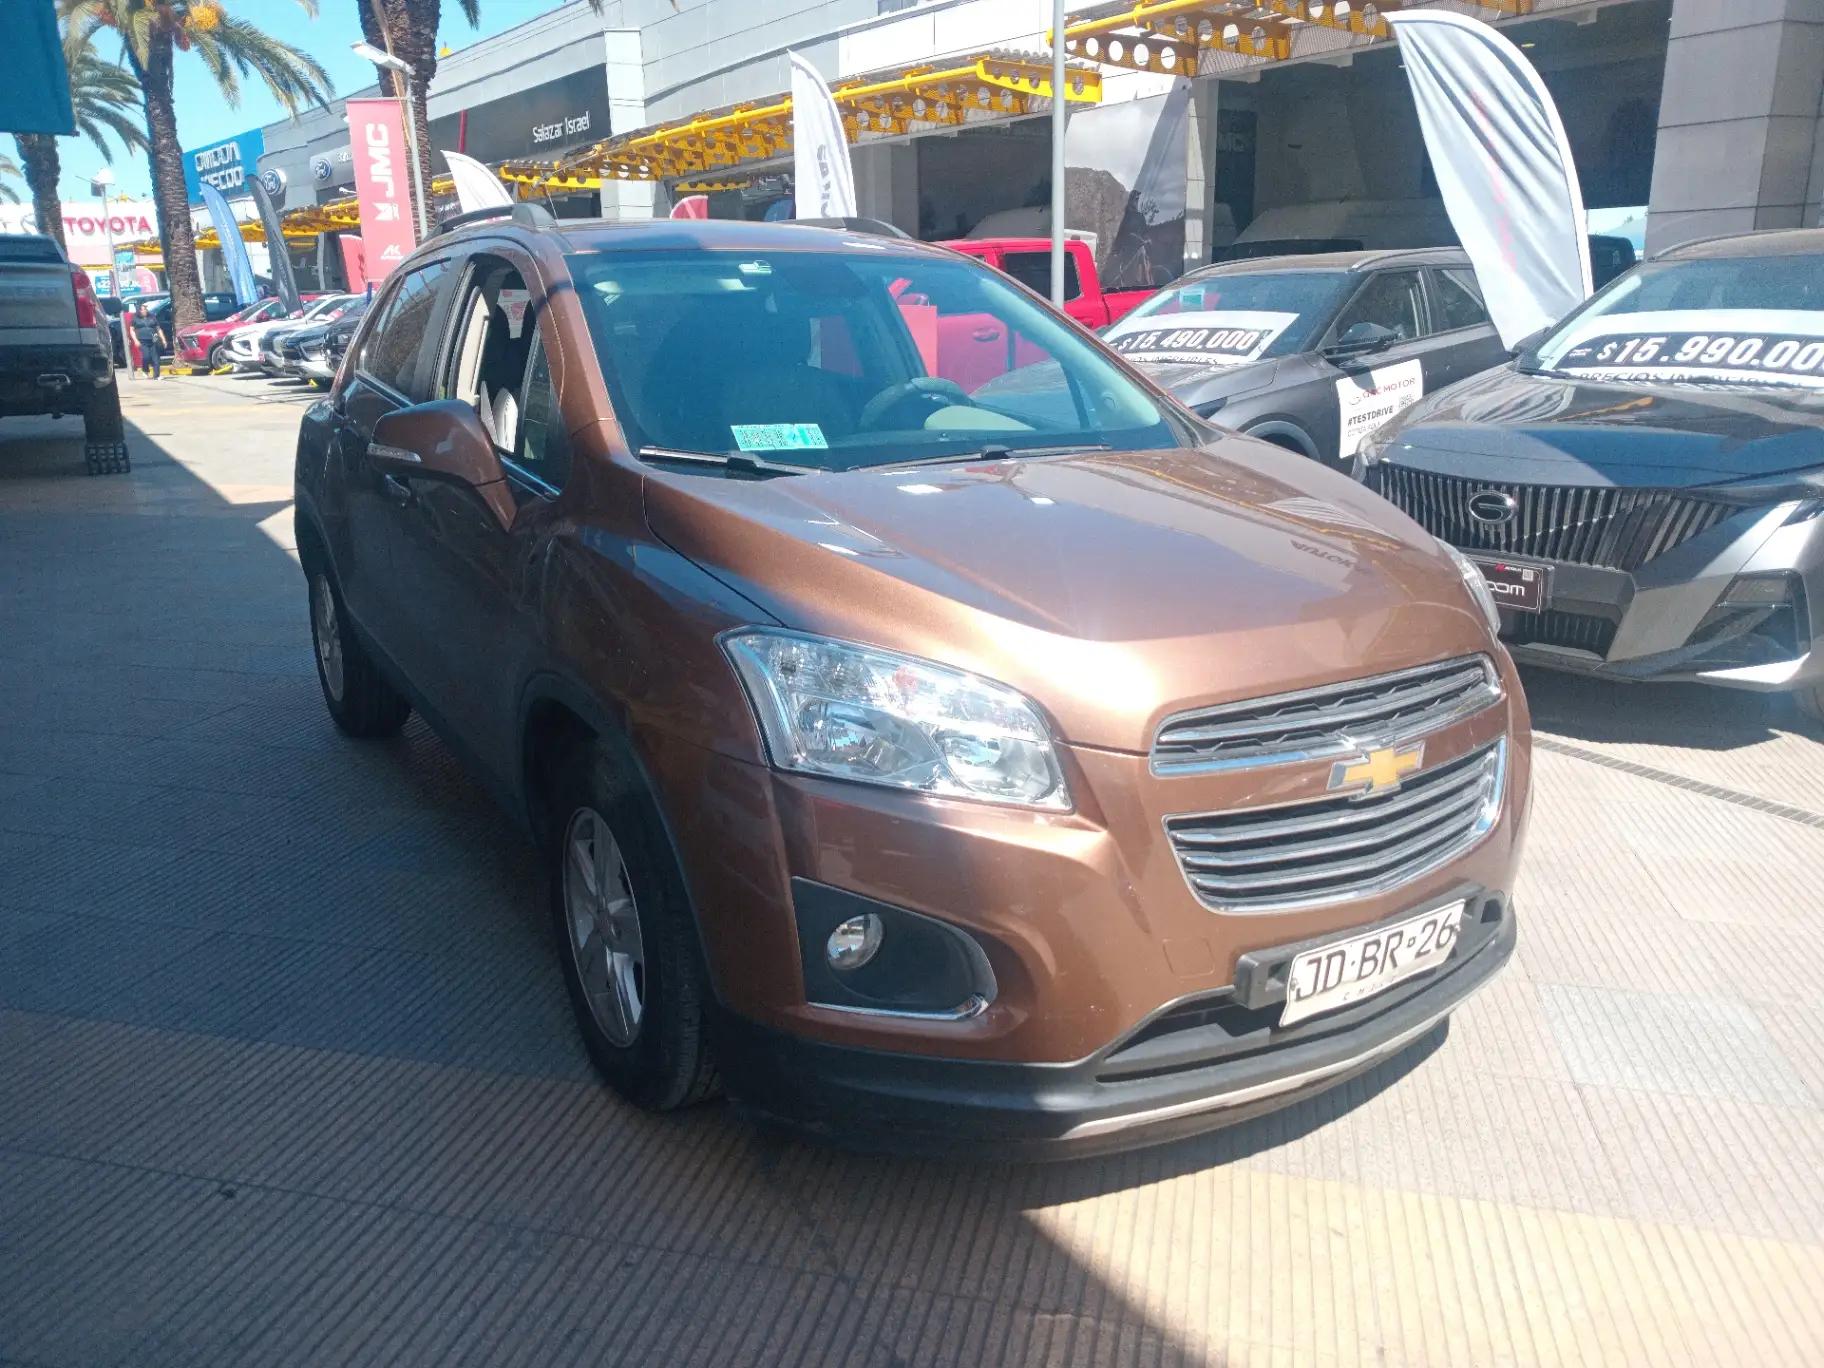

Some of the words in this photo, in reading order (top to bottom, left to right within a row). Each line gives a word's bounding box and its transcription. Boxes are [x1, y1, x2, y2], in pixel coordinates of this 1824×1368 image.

[532, 122, 563, 143] Salazar
[564, 110, 590, 136] Israel
[366, 123, 394, 198] JMC
[63, 215, 153, 236] TOYOTA
[1117, 329, 1261, 351] $15.490.000
[1596, 335, 1824, 373] $15.990.00
[1347, 405, 1394, 426] #TESTDRIVE
